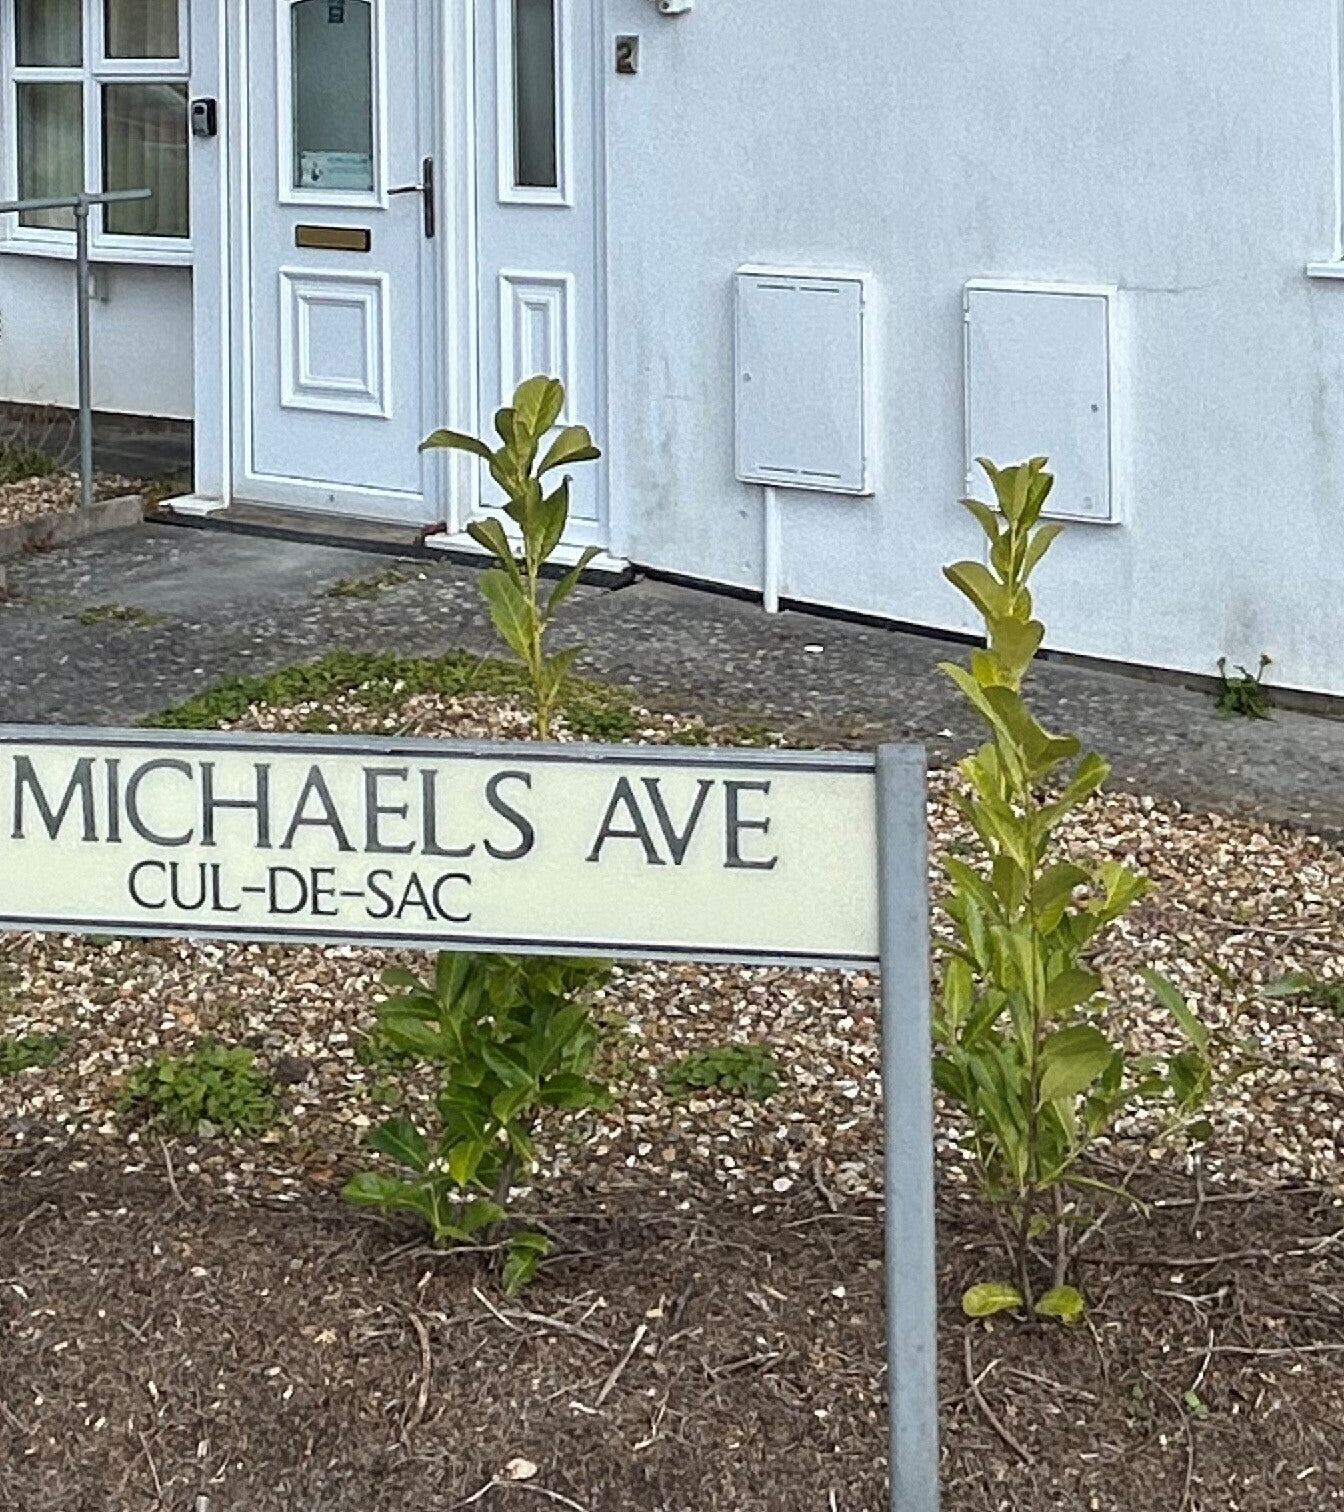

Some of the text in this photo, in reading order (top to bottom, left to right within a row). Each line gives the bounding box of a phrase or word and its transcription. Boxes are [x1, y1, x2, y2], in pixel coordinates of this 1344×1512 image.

[616, 41, 634, 74] 2
[11, 754, 535, 861] MICHAELS
[585, 776, 778, 870] AVE
[128, 860, 472, 924] CUL-DE-SAC
